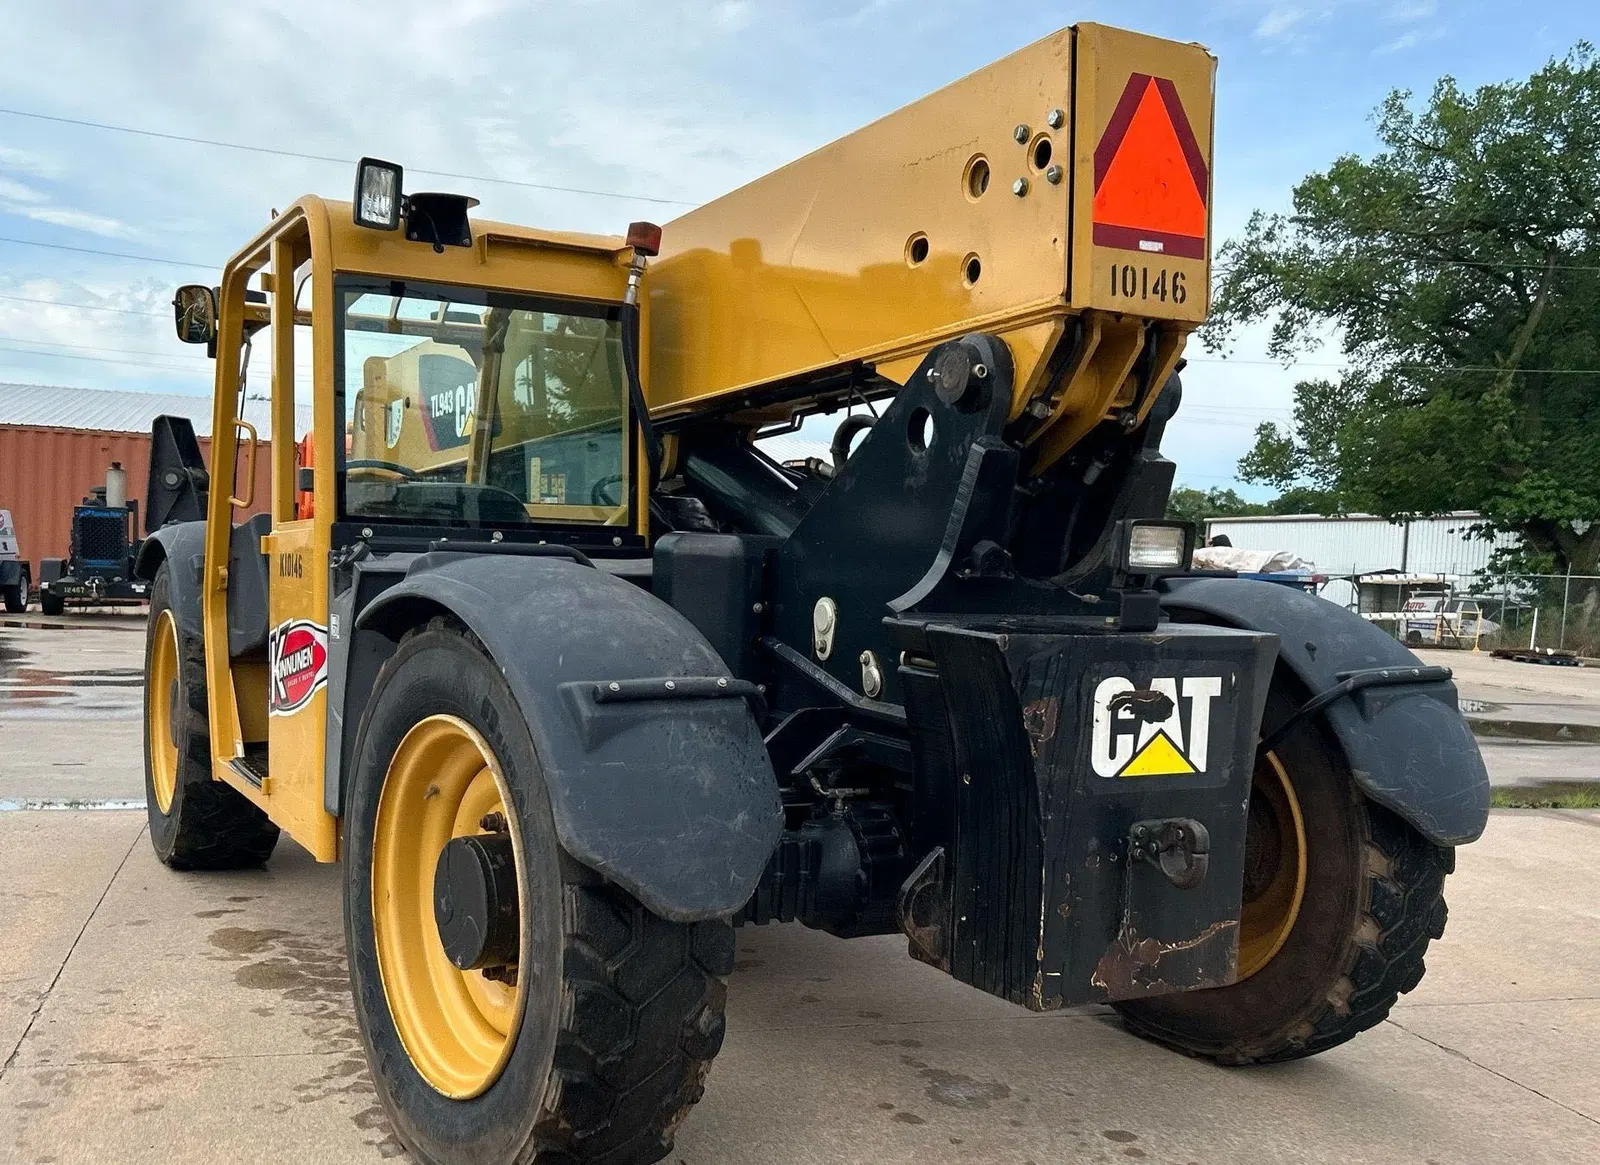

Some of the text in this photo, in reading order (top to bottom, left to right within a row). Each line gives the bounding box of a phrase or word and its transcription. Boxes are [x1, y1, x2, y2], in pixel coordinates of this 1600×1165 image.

[1111, 264, 1186, 304] 10146
[430, 389, 454, 419] TL943
[455, 380, 477, 438] CA
[280, 552, 303, 579] K10146
[1091, 676, 1222, 778] CAT
